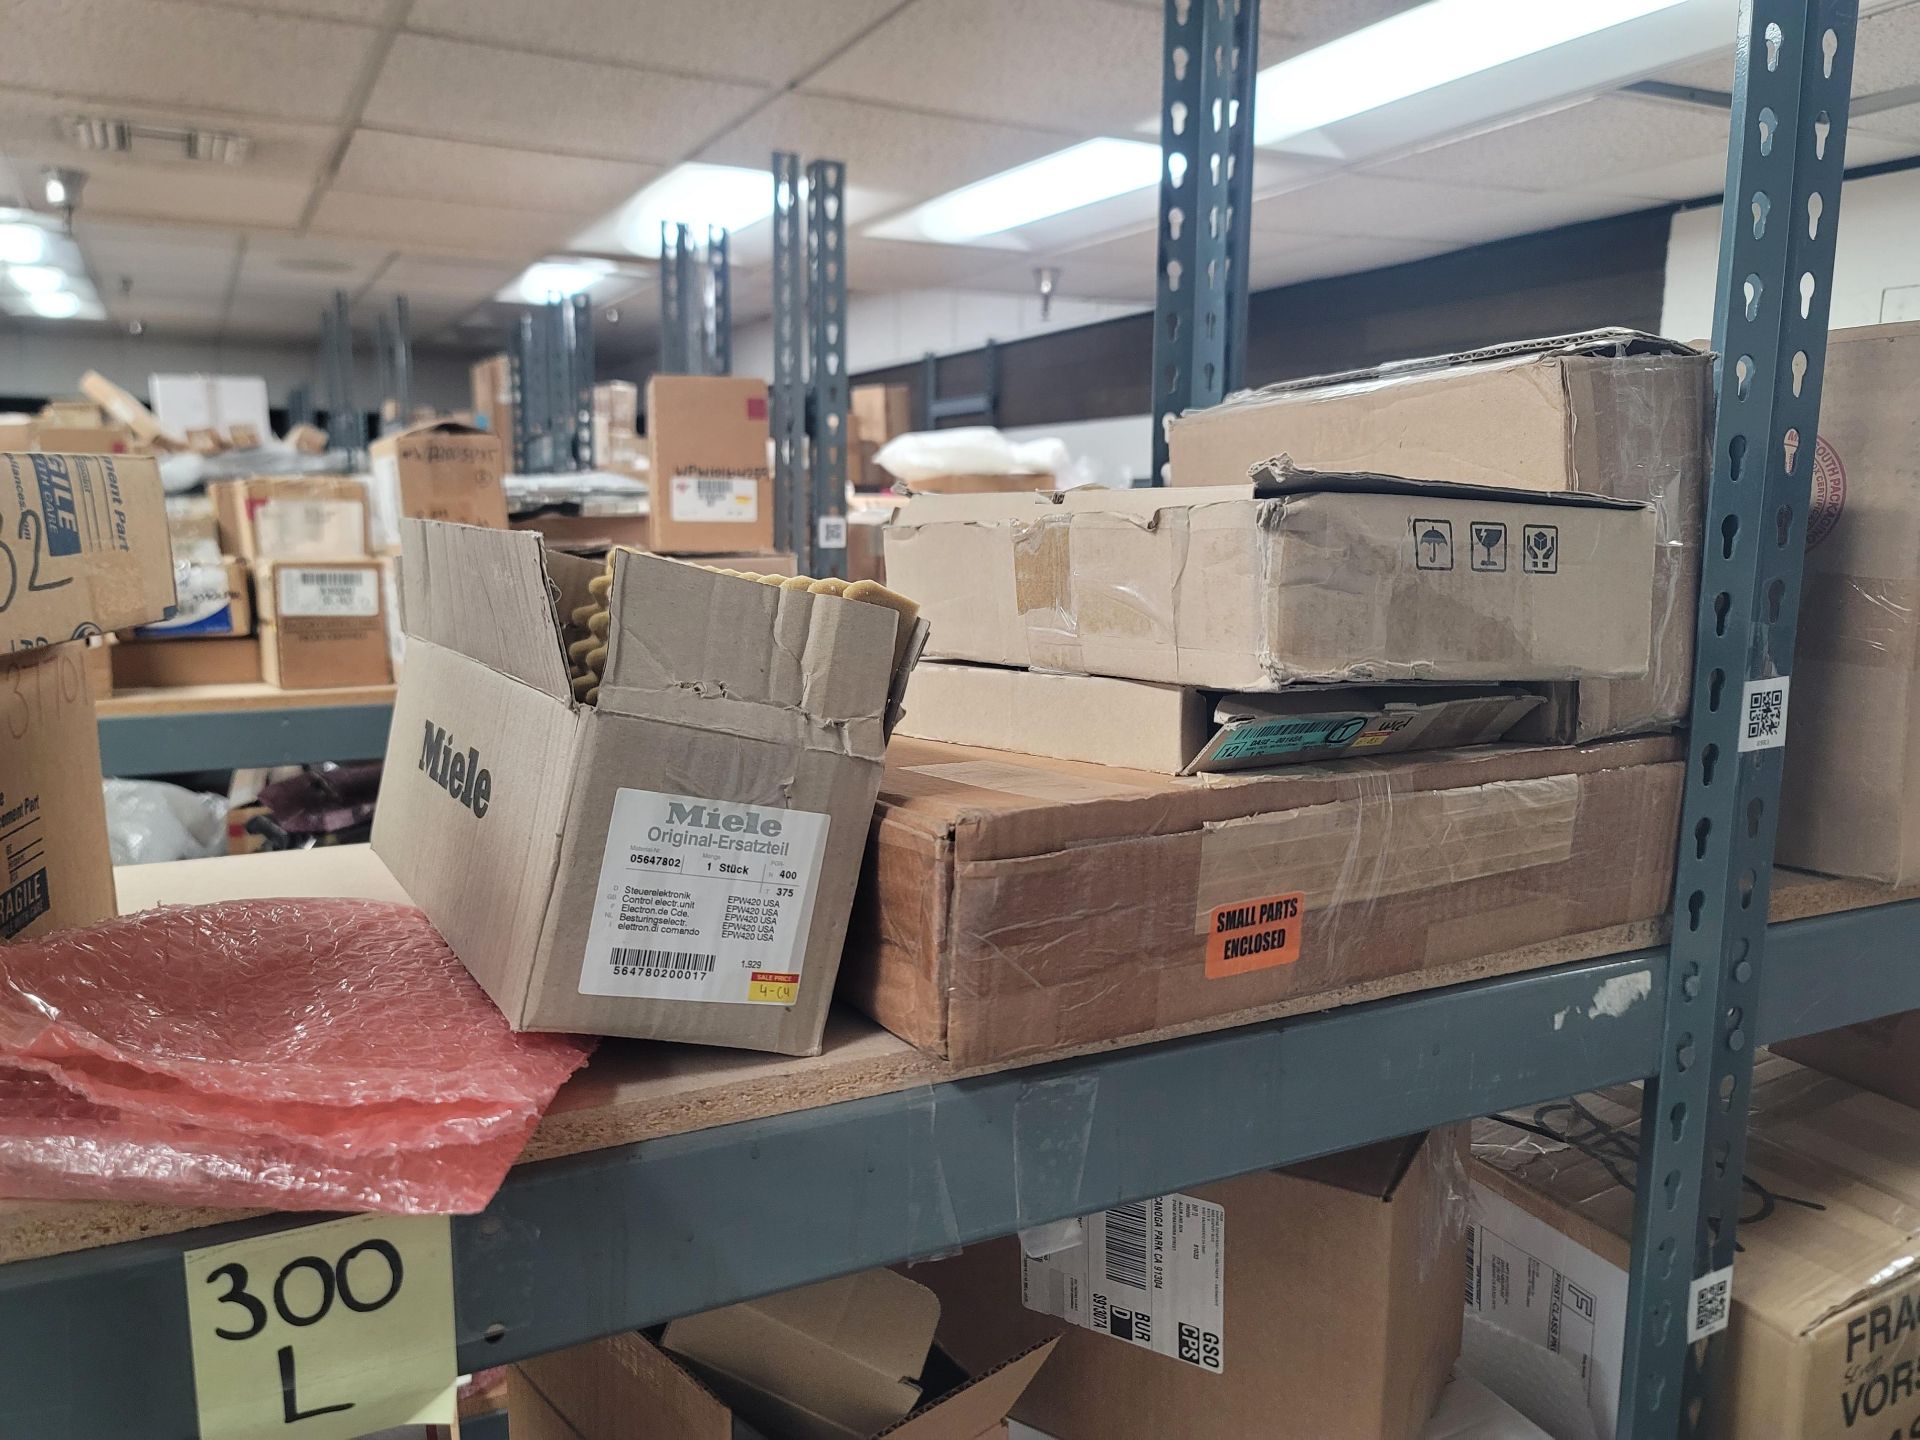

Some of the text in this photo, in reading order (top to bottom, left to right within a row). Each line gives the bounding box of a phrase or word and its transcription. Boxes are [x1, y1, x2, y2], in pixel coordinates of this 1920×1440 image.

[1816, 440, 1839, 476] OUTH
[44, 491, 58, 534] CARE
[114, 509, 129, 552] Part
[1221, 745, 1240, 757] 12
[418, 719, 492, 819] Miele
[0, 795, 40, 829] ement Part
[665, 802, 782, 837] Miele
[647, 826, 789, 856] Original-Ersatzteil
[630, 854, 681, 868] 05647802
[707, 862, 749, 875] 1 Stück
[779, 870, 797, 879] 400
[622, 895, 653, 905] Control
[655, 899, 695, 909] electr.unit
[624, 886, 691, 900] Steuerelektronik
[728, 895, 780, 908] EPW420 USA
[776, 888, 794, 897] 375
[619, 913, 688, 927] Besturingselectr.
[621, 904, 668, 916] Electron.de
[725, 913, 777, 925] EPW420 USA
[726, 905, 778, 917] EPW420 USA
[1217, 898, 1298, 933] SMALL PARTS
[618, 923, 659, 932] elettron.di
[721, 930, 774, 942] EPW420 USA
[722, 922, 774, 934] EPW420 USA
[1223, 928, 1286, 961] ENCLOSED
[613, 966, 707, 981] 564780200017
[1153, 1230, 1163, 1252] PARK
[1153, 1254, 1163, 1264] CA
[1154, 1265, 1163, 1289] 91304
[206, 1238, 404, 1341] 300
[1568, 1283, 1593, 1317] F
[1093, 1293, 1108, 1329] S91307A
[1112, 1305, 1131, 1319] D
[1551, 1272, 1561, 1335] FIRST-CLASS
[1134, 1311, 1150, 1342] BUR
[1847, 1295, 1920, 1363] FRA
[1180, 1325, 1200, 1361] CPS
[1203, 1332, 1219, 1368] GSO
[277, 1345, 356, 1424] L
